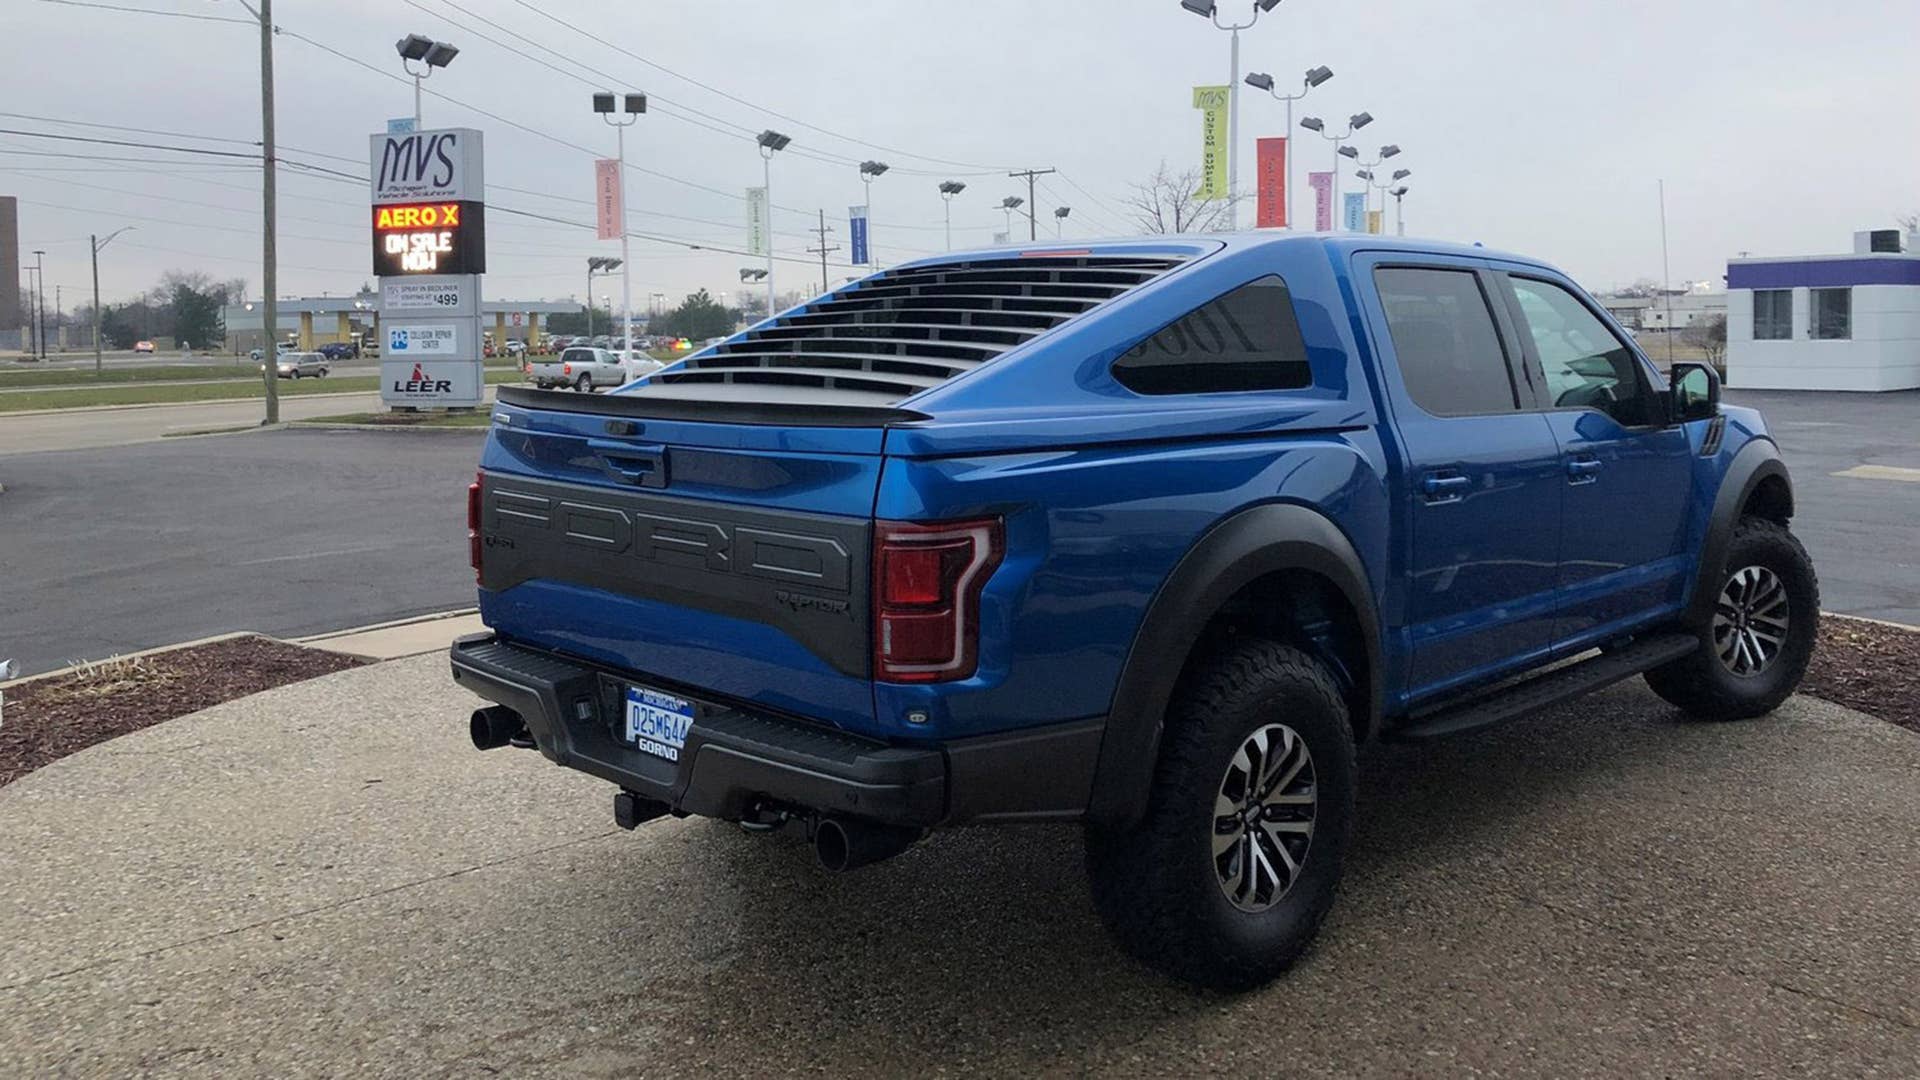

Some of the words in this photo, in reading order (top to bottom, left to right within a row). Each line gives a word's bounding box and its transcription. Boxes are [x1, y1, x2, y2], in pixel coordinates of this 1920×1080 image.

[1205, 111, 1216, 147] CUSTOM
[378, 133, 457, 192] MVS
[377, 206, 438, 229] AERO
[441, 204, 459, 226] X
[385, 234, 409, 254] ON
[410, 231, 453, 252] SALE
[401, 250, 437, 271] NOW
[433, 293, 458, 306] $499
[394, 380, 452, 393] LEER
[492, 489, 852, 594] FORD
[639, 737, 678, 761] GORNO
